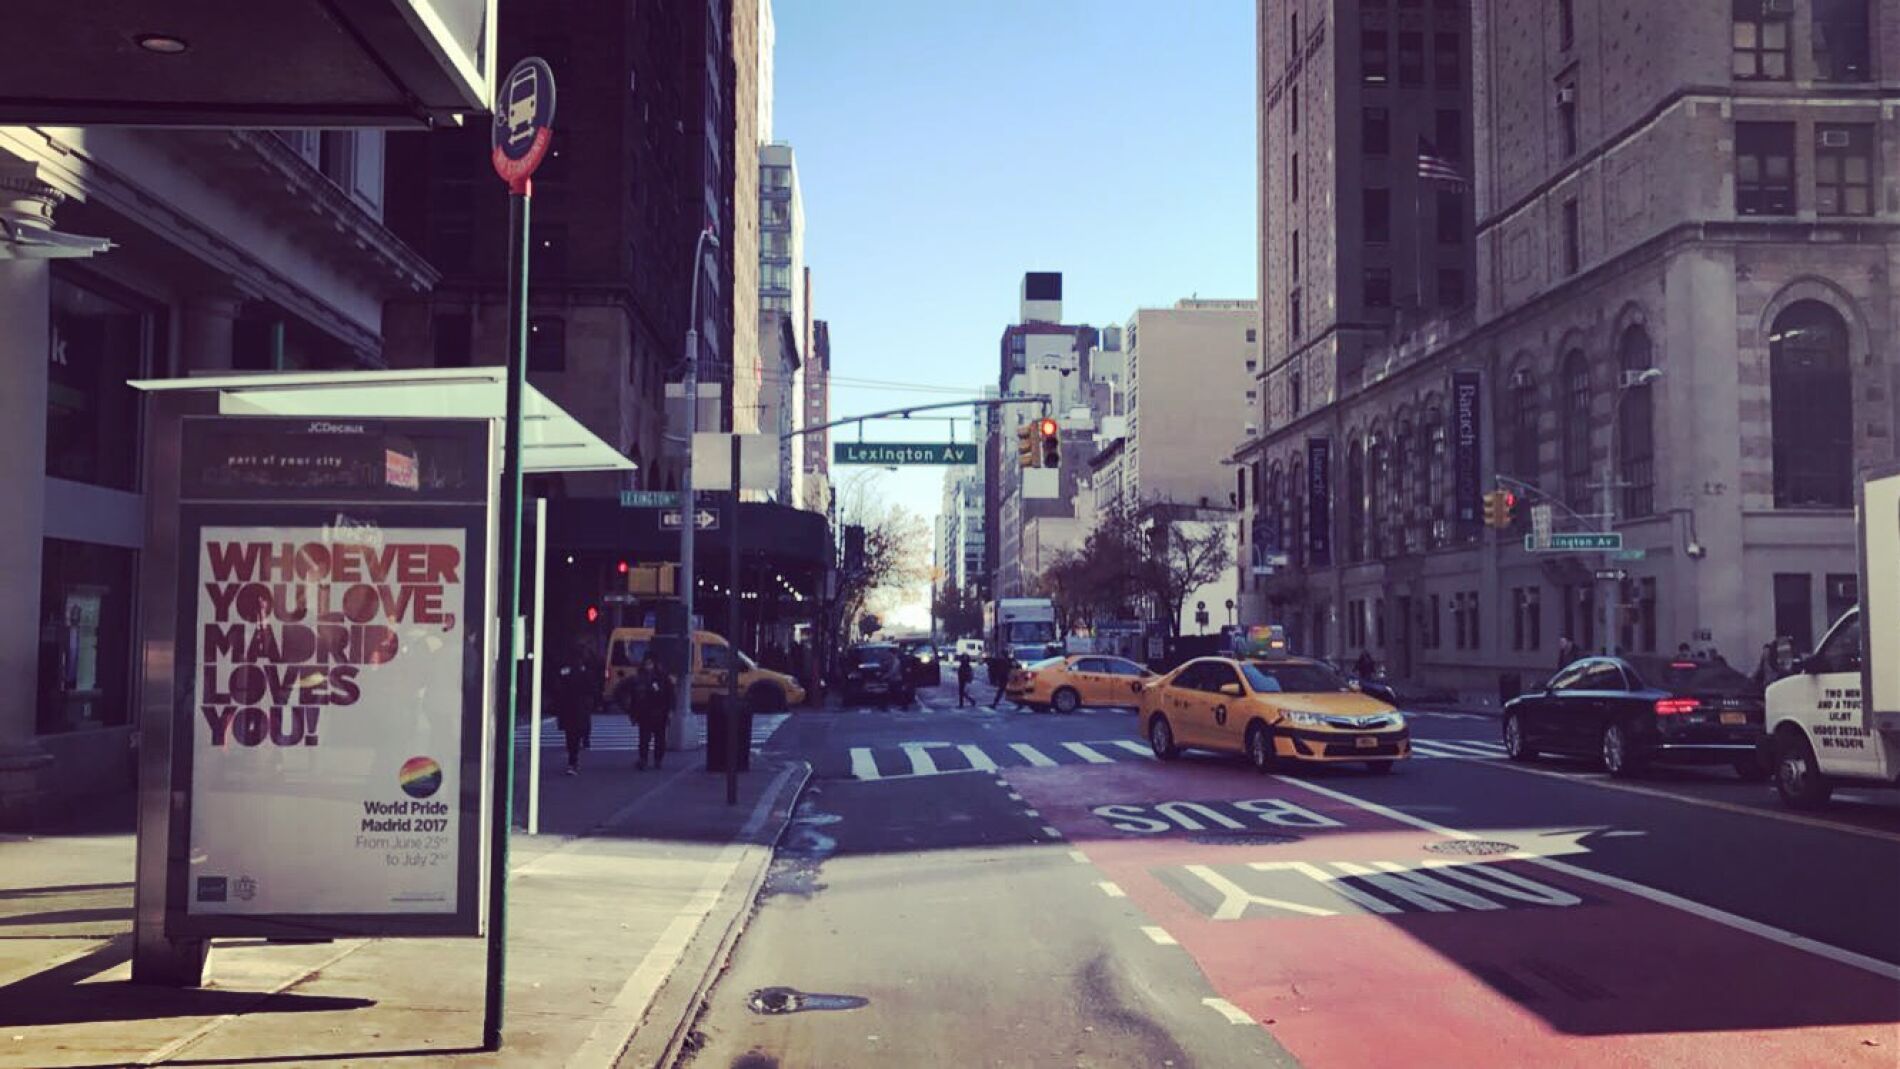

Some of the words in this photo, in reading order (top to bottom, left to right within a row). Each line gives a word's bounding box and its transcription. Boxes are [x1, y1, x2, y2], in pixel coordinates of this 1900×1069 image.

[1459, 384, 1475, 446] Baruch
[308, 422, 364, 434] JCDecaux
[228, 456, 257, 466] part
[316, 456, 342, 467] city
[847, 447, 933, 463] Lexington
[943, 449, 965, 460] Av
[1598, 537, 1611, 546] Av
[206, 542, 461, 583] WHOEVER
[205, 583, 308, 622] YOU
[316, 584, 456, 632] LOVE,
[204, 624, 400, 664] MADRID
[202, 664, 361, 705] LOVES
[1843, 700, 1862, 709] TRUC
[201, 706, 320, 746] YOU!
[363, 801, 408, 815] World
[411, 801, 448, 815] Pride
[1093, 798, 1347, 833] BUS
[361, 819, 411, 832] Madrid
[414, 819, 448, 832] 2017
[355, 834, 389, 848] From
[392, 835, 423, 849] June
[386, 854, 399, 866] to
[402, 853, 428, 867] July
[1183, 861, 1582, 920] ONLY
